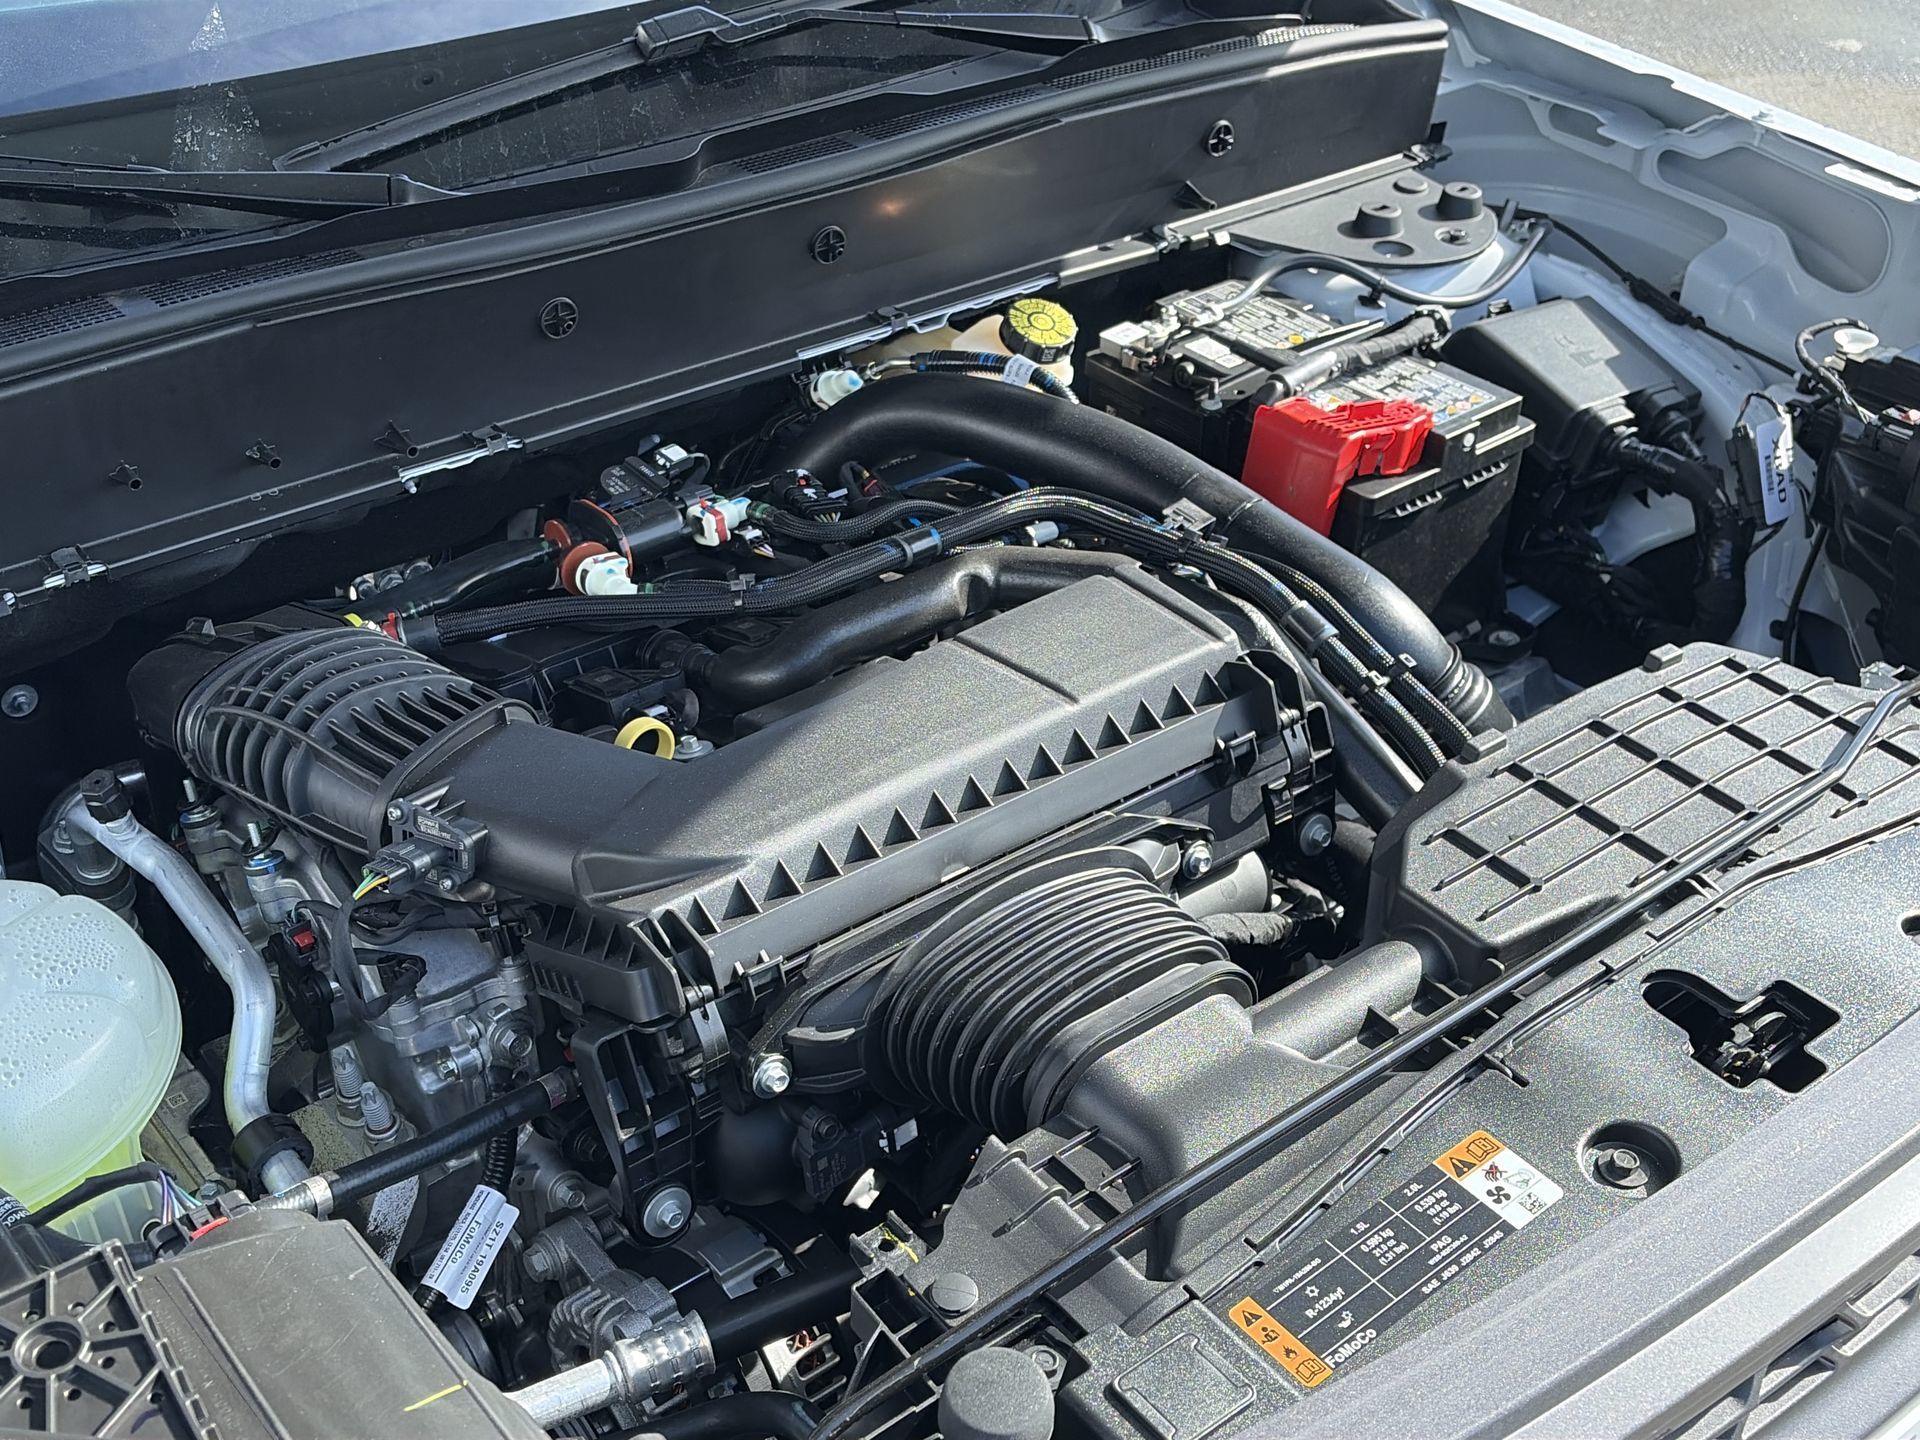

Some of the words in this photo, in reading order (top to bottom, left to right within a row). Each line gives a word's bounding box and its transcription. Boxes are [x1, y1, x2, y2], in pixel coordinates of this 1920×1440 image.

[1403, 1182, 1424, 1197] 2.0L
[1414, 1195, 1436, 1212] 0.539
[1432, 1189, 1448, 1200] kg
[450, 1219, 482, 1264] FoMoCo
[1350, 1221, 1371, 1235] 1.5L
[1360, 1233, 1383, 1253] 0.595
[1379, 1227, 1395, 1239] kg
[1430, 1235, 1452, 1252] PAG
[460, 1253, 487, 1294] 19A095
[1421, 1278, 1441, 1294] SAE
[1440, 1264, 1460, 1281] J639
[1304, 1286, 1346, 1319] R-1234yf
[1324, 1328, 1377, 1369] FoMoCo
